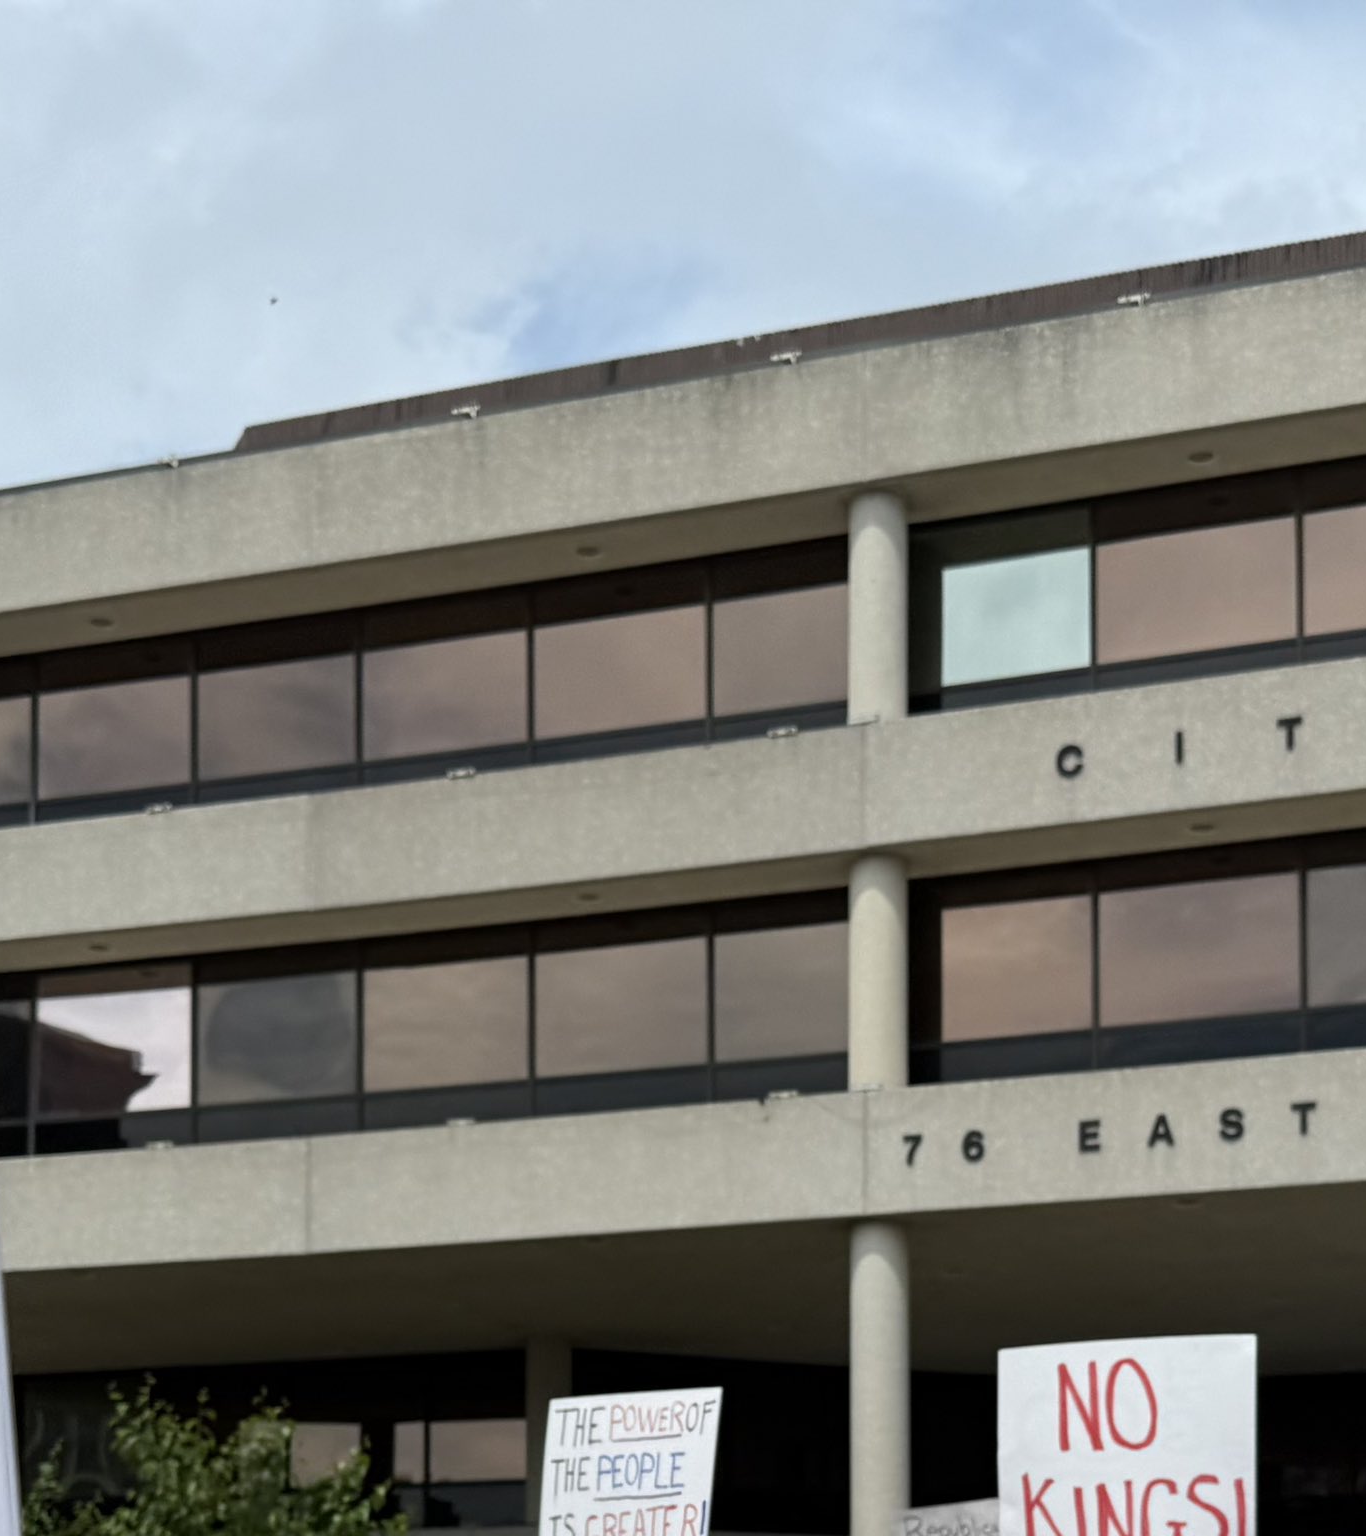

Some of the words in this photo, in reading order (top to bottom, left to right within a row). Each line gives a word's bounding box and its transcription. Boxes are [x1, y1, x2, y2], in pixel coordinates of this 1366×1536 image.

[901, 1127, 986, 1167] 76
[1077, 1100, 1319, 1155] EAST
[555, 1406, 606, 1447] THE
[610, 1401, 685, 1438] POWER
[685, 1400, 716, 1433] OF
[1057, 1358, 1158, 1452] NO
[551, 1457, 590, 1497] THE
[596, 1453, 686, 1494] PEOPLE
